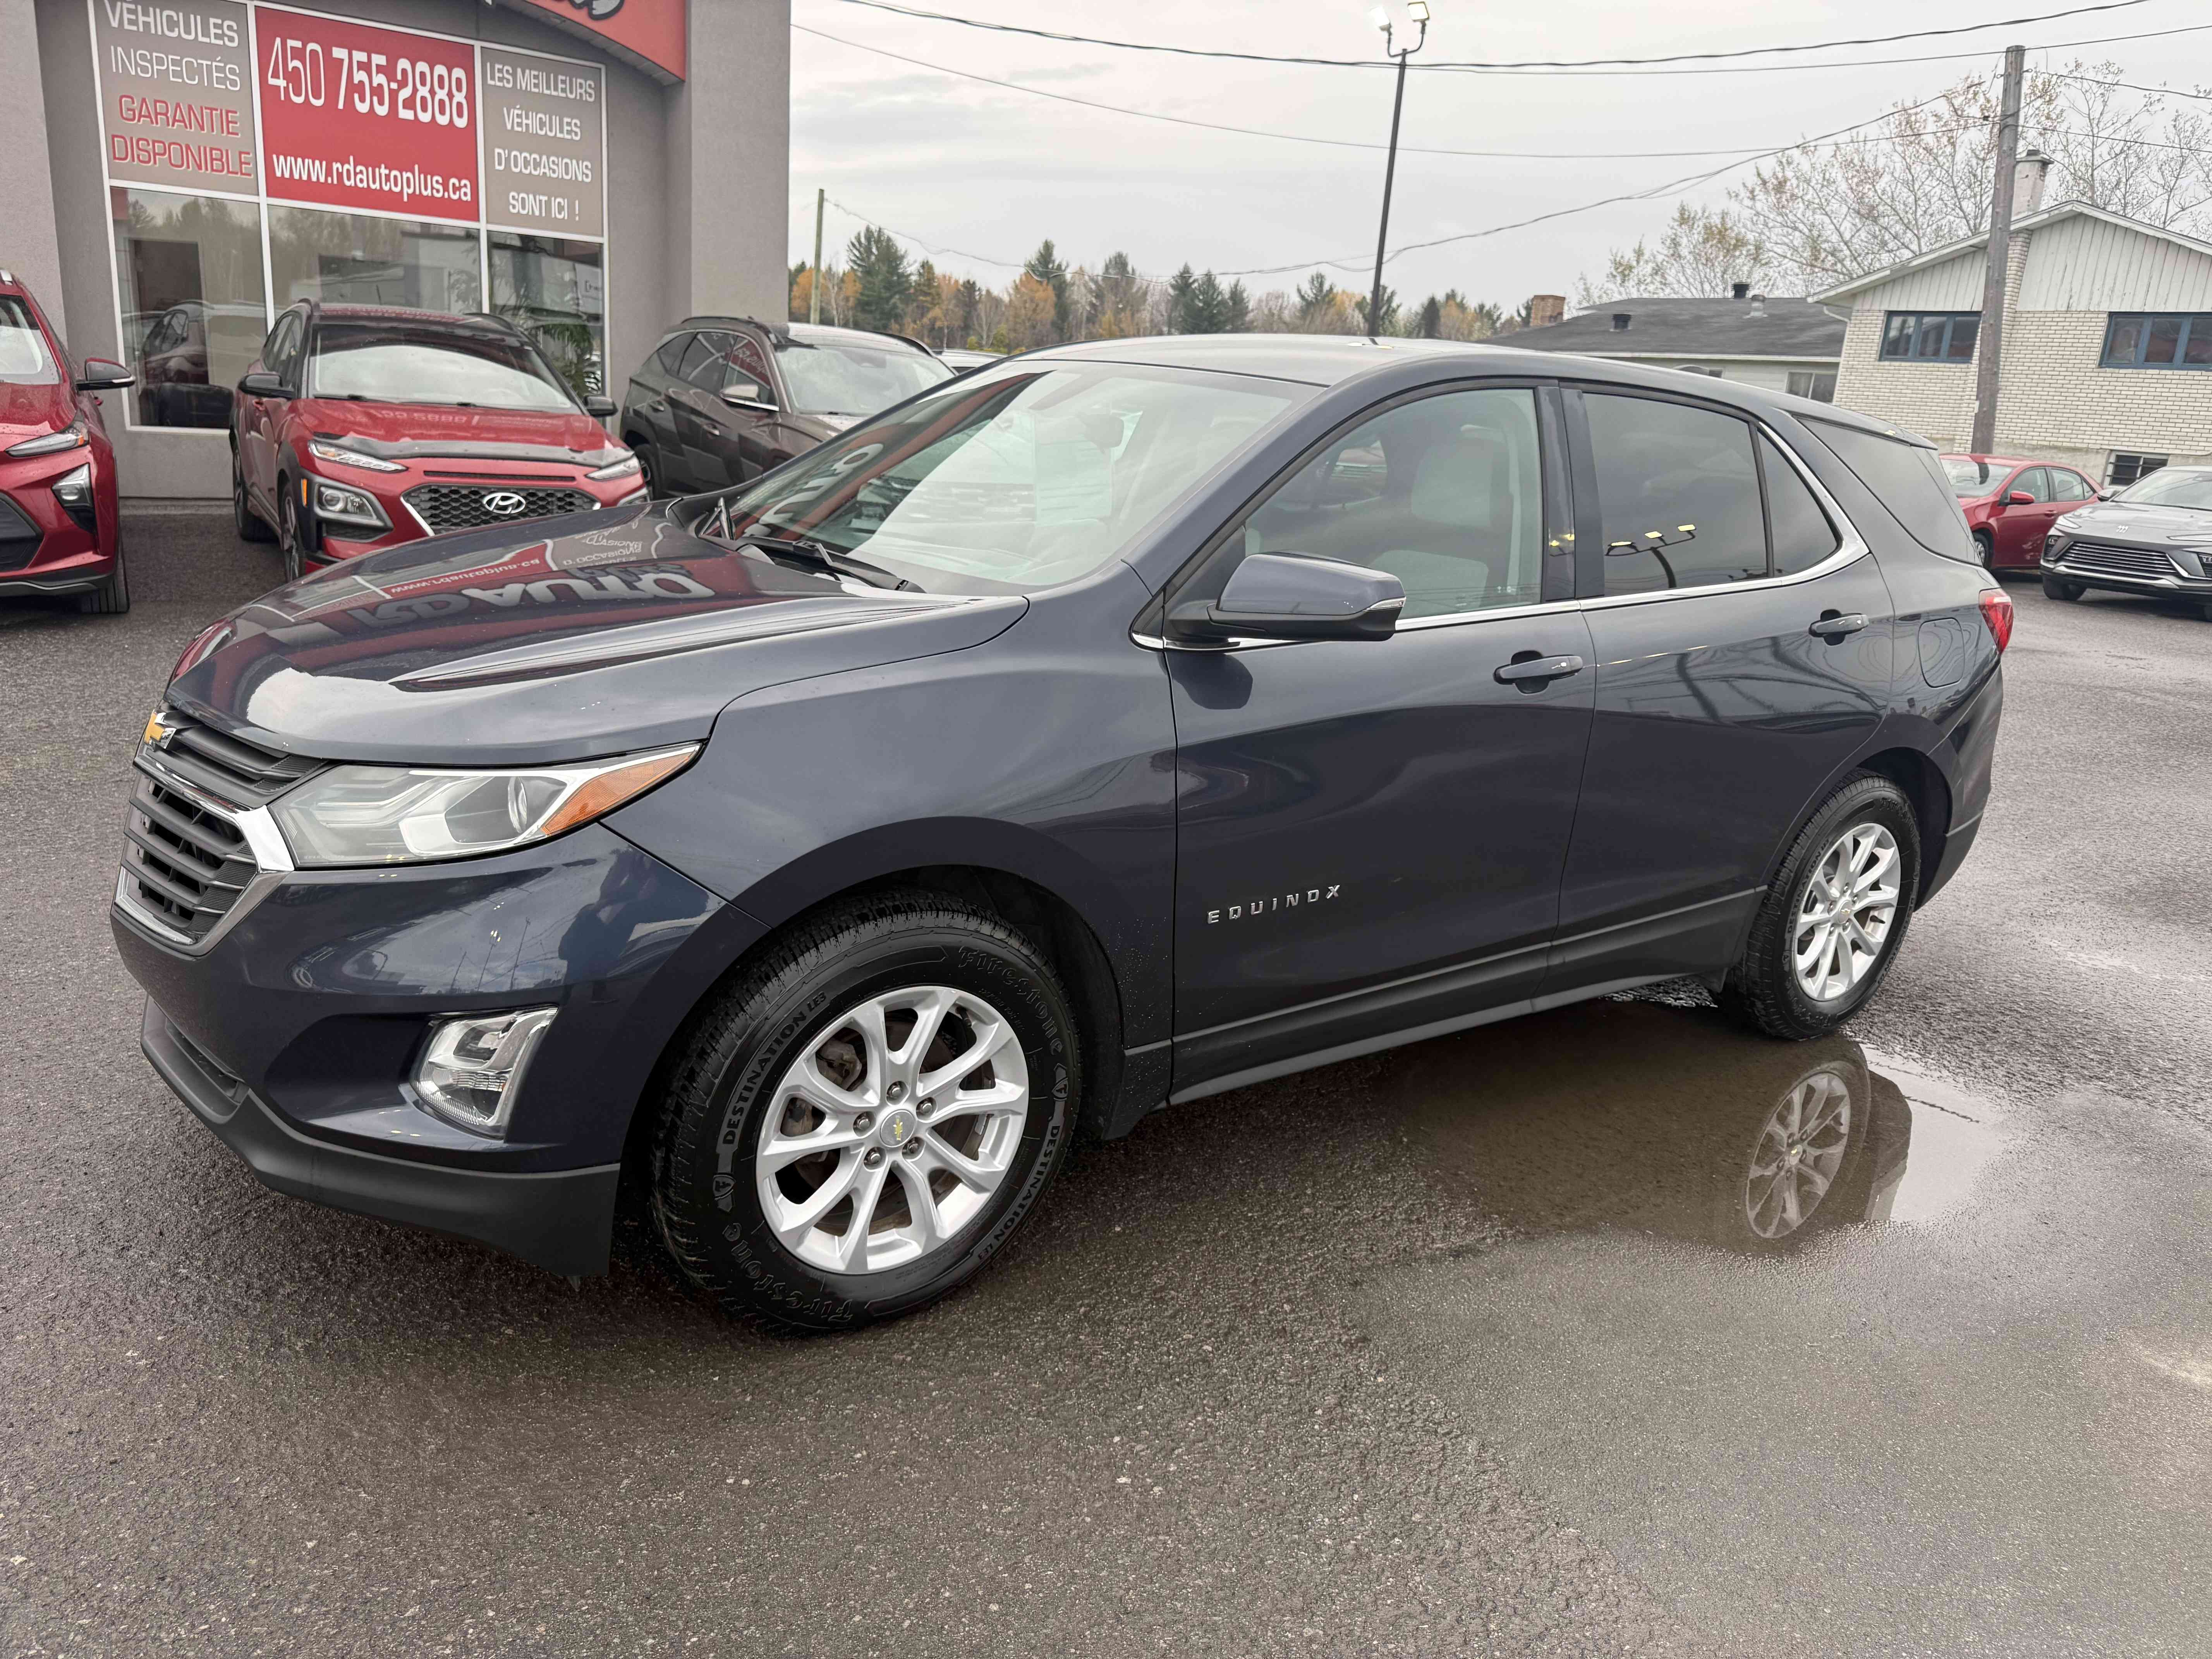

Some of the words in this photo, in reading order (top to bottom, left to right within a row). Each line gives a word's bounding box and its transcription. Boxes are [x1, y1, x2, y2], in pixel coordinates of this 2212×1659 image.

[106, 0, 239, 47] VÉHICULES
[110, 45, 240, 91] INSPECTÉS
[268, 37, 325, 107] 450
[332, 46, 469, 129] 755-2888
[486, 61, 513, 89] LES
[517, 68, 595, 103] MEILLEURS
[118, 94, 240, 137] GARANTIE
[503, 105, 581, 141] VÉHICULES
[111, 134, 253, 178] DISPONIBLE
[272, 153, 471, 202] www.rdautoplus.ca
[509, 191, 547, 215] SONT
[551, 198, 568, 220] ICI
[1207, 884, 1341, 924] EQUINOX
[722, 1010, 807, 1145] DESTINATION
[807, 991, 827, 1013] LE3
[993, 1125, 1061, 1242] DESTINATION
